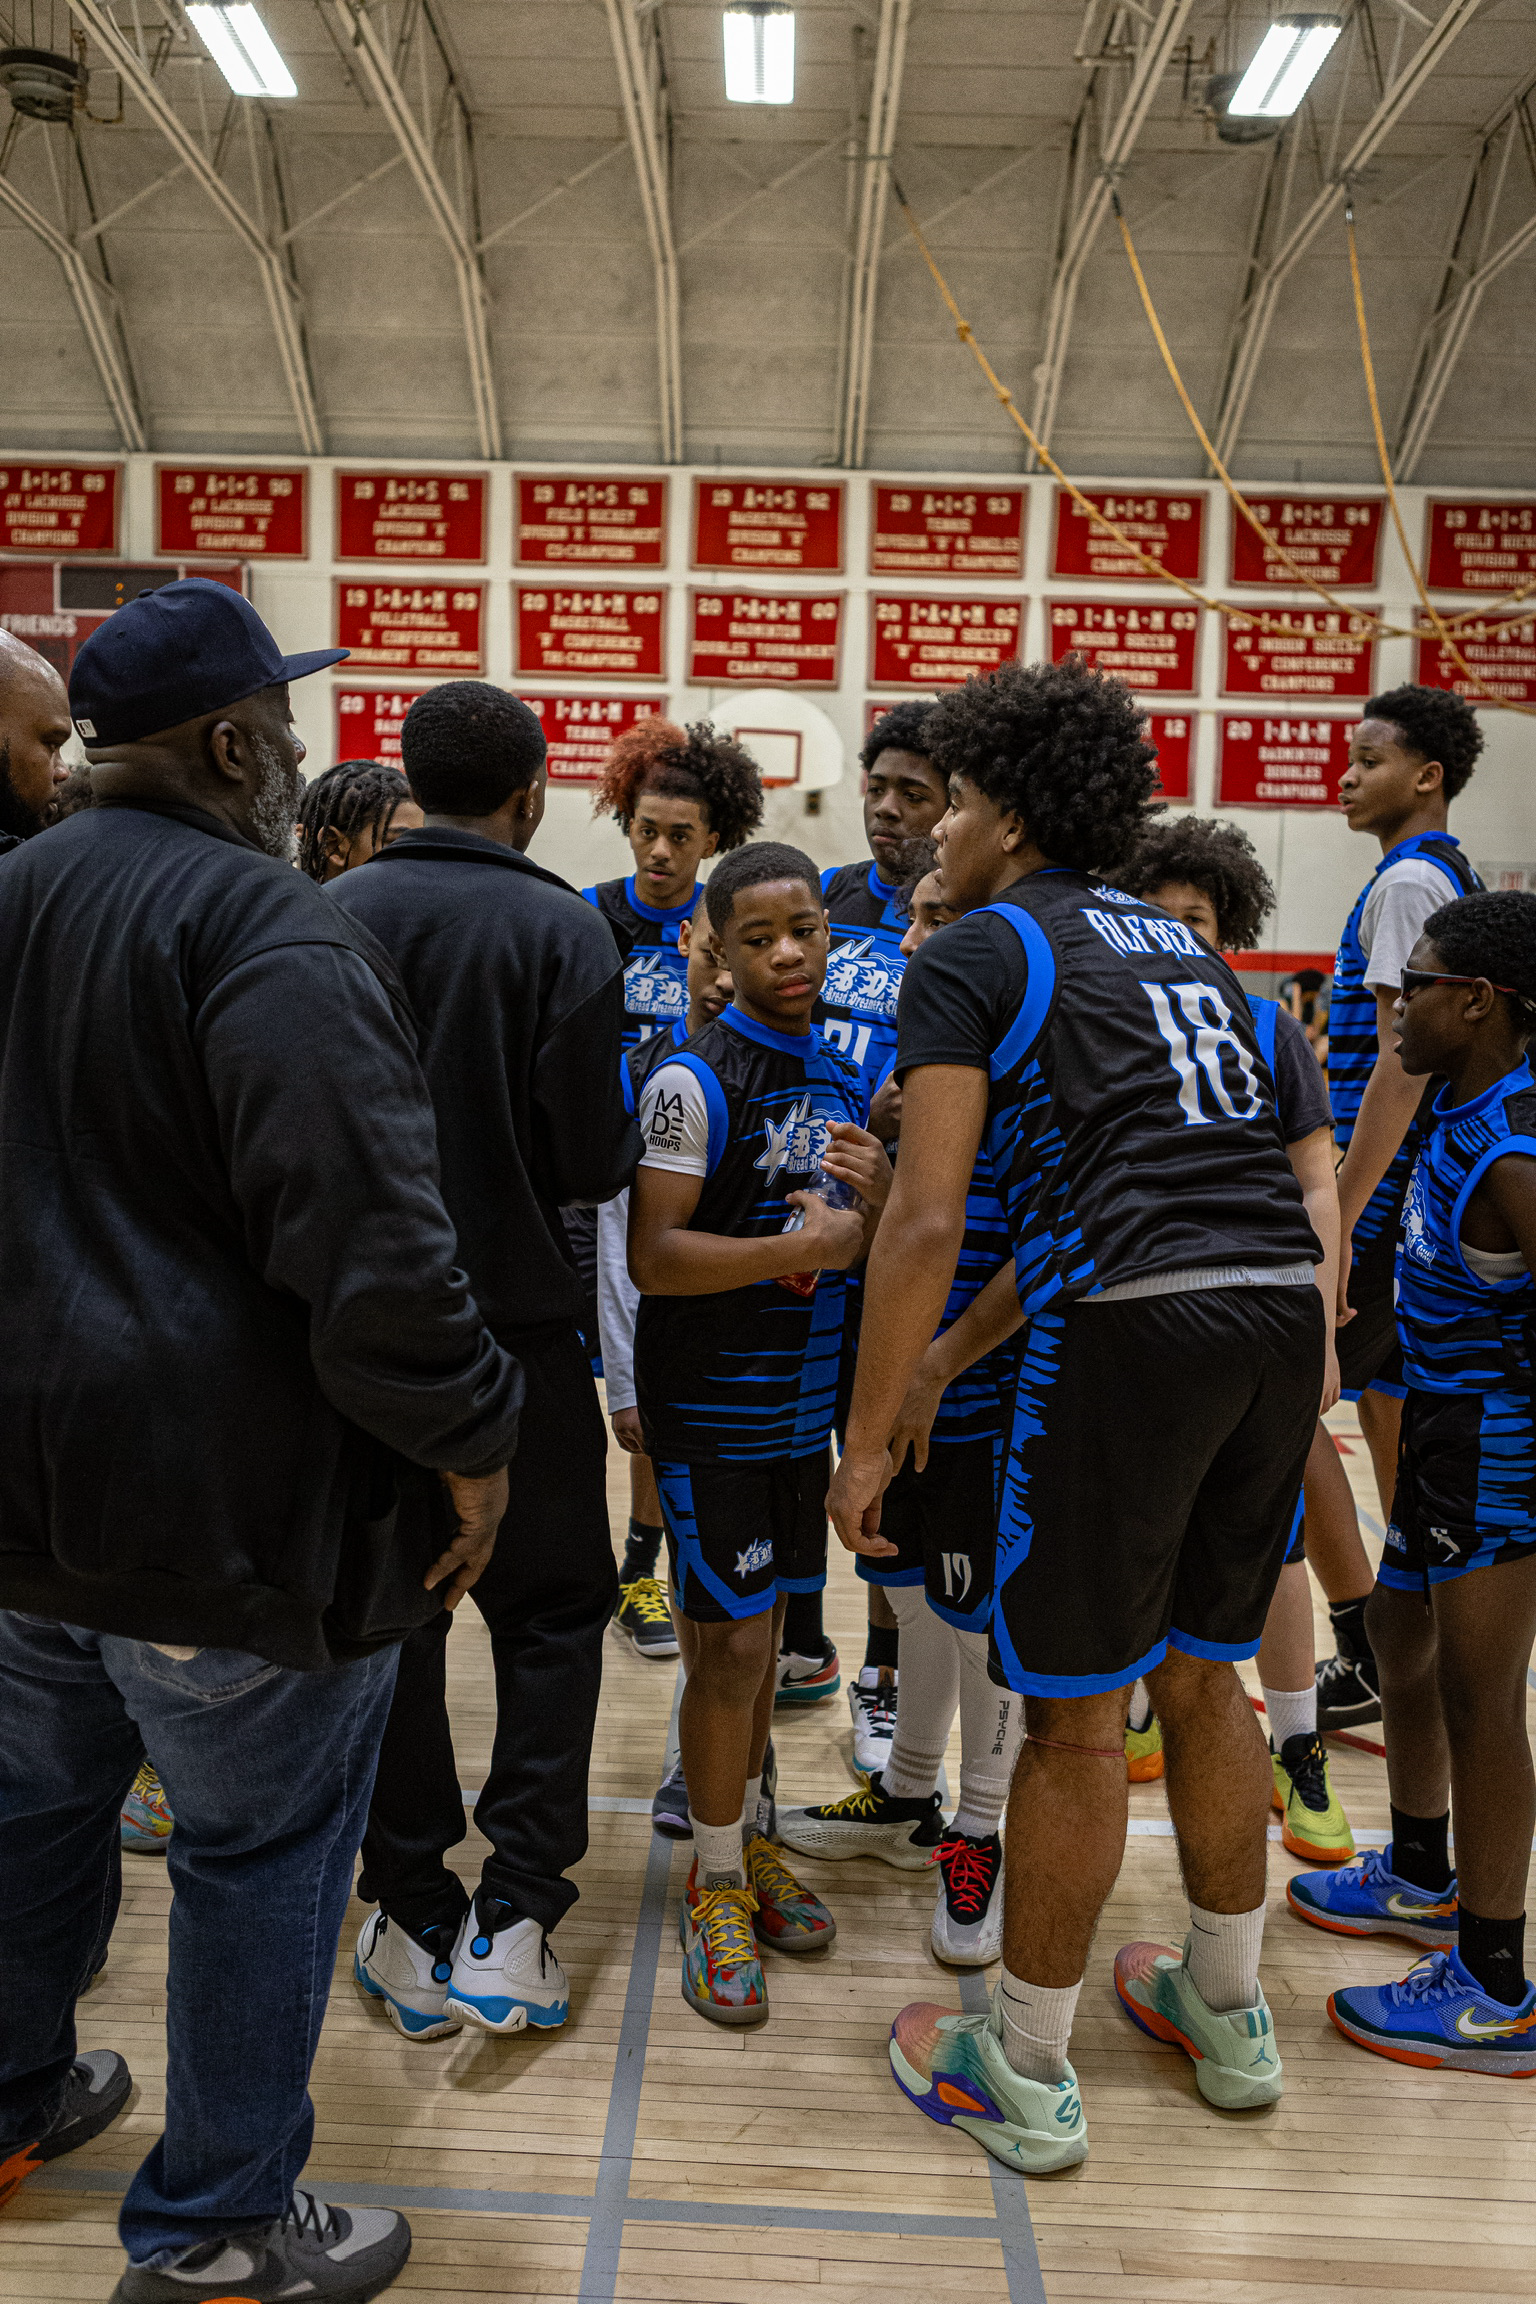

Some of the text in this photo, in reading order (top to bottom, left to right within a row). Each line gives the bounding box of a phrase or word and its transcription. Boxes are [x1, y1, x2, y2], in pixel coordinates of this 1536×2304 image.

[174, 475, 195, 494] 19
[354, 481, 375, 499] 19
[25, 494, 87, 510] LACROSSE
[533, 485, 555, 503] 19
[712, 489, 733, 507] 19
[890, 494, 912, 512] 19
[210, 498, 274, 515] LACROSSE
[379, 503, 444, 519] LACROSSE
[546, 507, 637, 524] FIELD HOCKEY
[5, 511, 59, 527] DIVISION
[191, 515, 245, 531] DIVISION
[729, 511, 808, 528] BASKETBALL
[926, 517, 972, 533] TENNIS
[1444, 509, 1467, 528] 19
[11, 528, 79, 546] CHAMPIONS
[373, 520, 427, 536] DIVISION
[518, 524, 568, 541] DIVISION
[589, 525, 661, 543] TOURNAMENT
[727, 528, 782, 546] DIVISION
[1285, 528, 1353, 546] LACROSSE
[196, 532, 267, 550] CHAMPIONS
[375, 539, 446, 555] CHAMPIONS
[874, 533, 928, 550] DIVISION
[968, 536, 1021, 553] SINGLES
[1454, 532, 1495, 550] FIELD
[545, 543, 635, 560] CO-CHAMPIONS
[731, 547, 803, 564] CHAMPIONS
[1460, 552, 1518, 569] DIVISION
[873, 552, 1020, 570] TOURNAMENT CHAMPIONS
[346, 588, 368, 607] 19
[522, 593, 548, 612] 20
[697, 598, 723, 616] 20
[877, 603, 902, 622] 20
[370, 611, 450, 628] VOLLEYBALL
[550, 614, 630, 632] BASKETBALL
[1052, 607, 1079, 627] 20
[381, 629, 460, 648] CONFERENCE
[729, 621, 801, 640] BADMINTON
[908, 625, 956, 642] INDOOR
[960, 627, 1012, 645] SOCCER
[563, 633, 644, 652] CONFERENCE
[1071, 630, 1177, 650] INDOOR SOCCER
[1258, 637, 1307, 654] INDOOR
[415, 649, 478, 666] CHAMPIONS
[691, 640, 837, 660] DOUBLES TOURNAMENT
[919, 644, 1000, 663] CONFERENCE
[727, 660, 798, 677] CHAMPIONS
[1095, 650, 1179, 669] CONFERENCE
[1271, 656, 1356, 674] CONFERENCE
[1260, 674, 1335, 692] CHAMPIONS
[340, 695, 365, 714] 20
[565, 725, 612, 742] TENNIS
[1227, 720, 1253, 741] 20
[1258, 746, 1331, 764] BADMINTON
[1264, 764, 1323, 781] DOUBLES
[1256, 782, 1328, 800] CHAMPIONS
[1139, 980, 1264, 1126] 18
[649, 1134, 681, 1151] HOOPS
[991, 1700, 1011, 1756] PSYCHE
